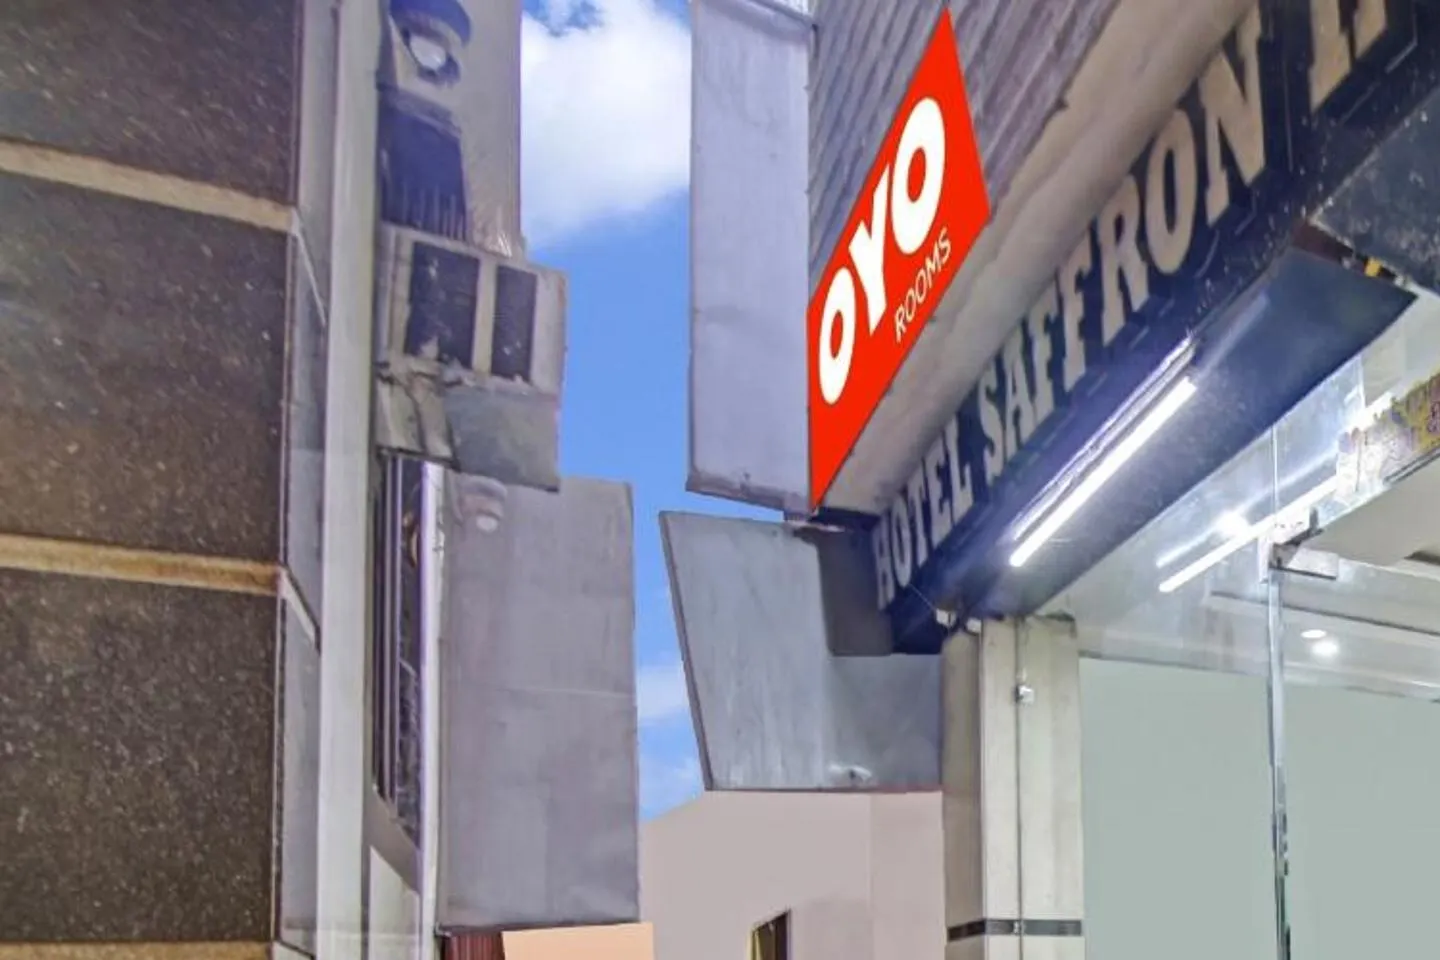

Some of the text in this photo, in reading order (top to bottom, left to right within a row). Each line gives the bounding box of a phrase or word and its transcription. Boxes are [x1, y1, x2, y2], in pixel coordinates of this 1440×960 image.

[819, 98, 946, 404] OYO
[873, 0, 1264, 611] HOTEL SAFFRON
[894, 226, 952, 343] ROOMS
